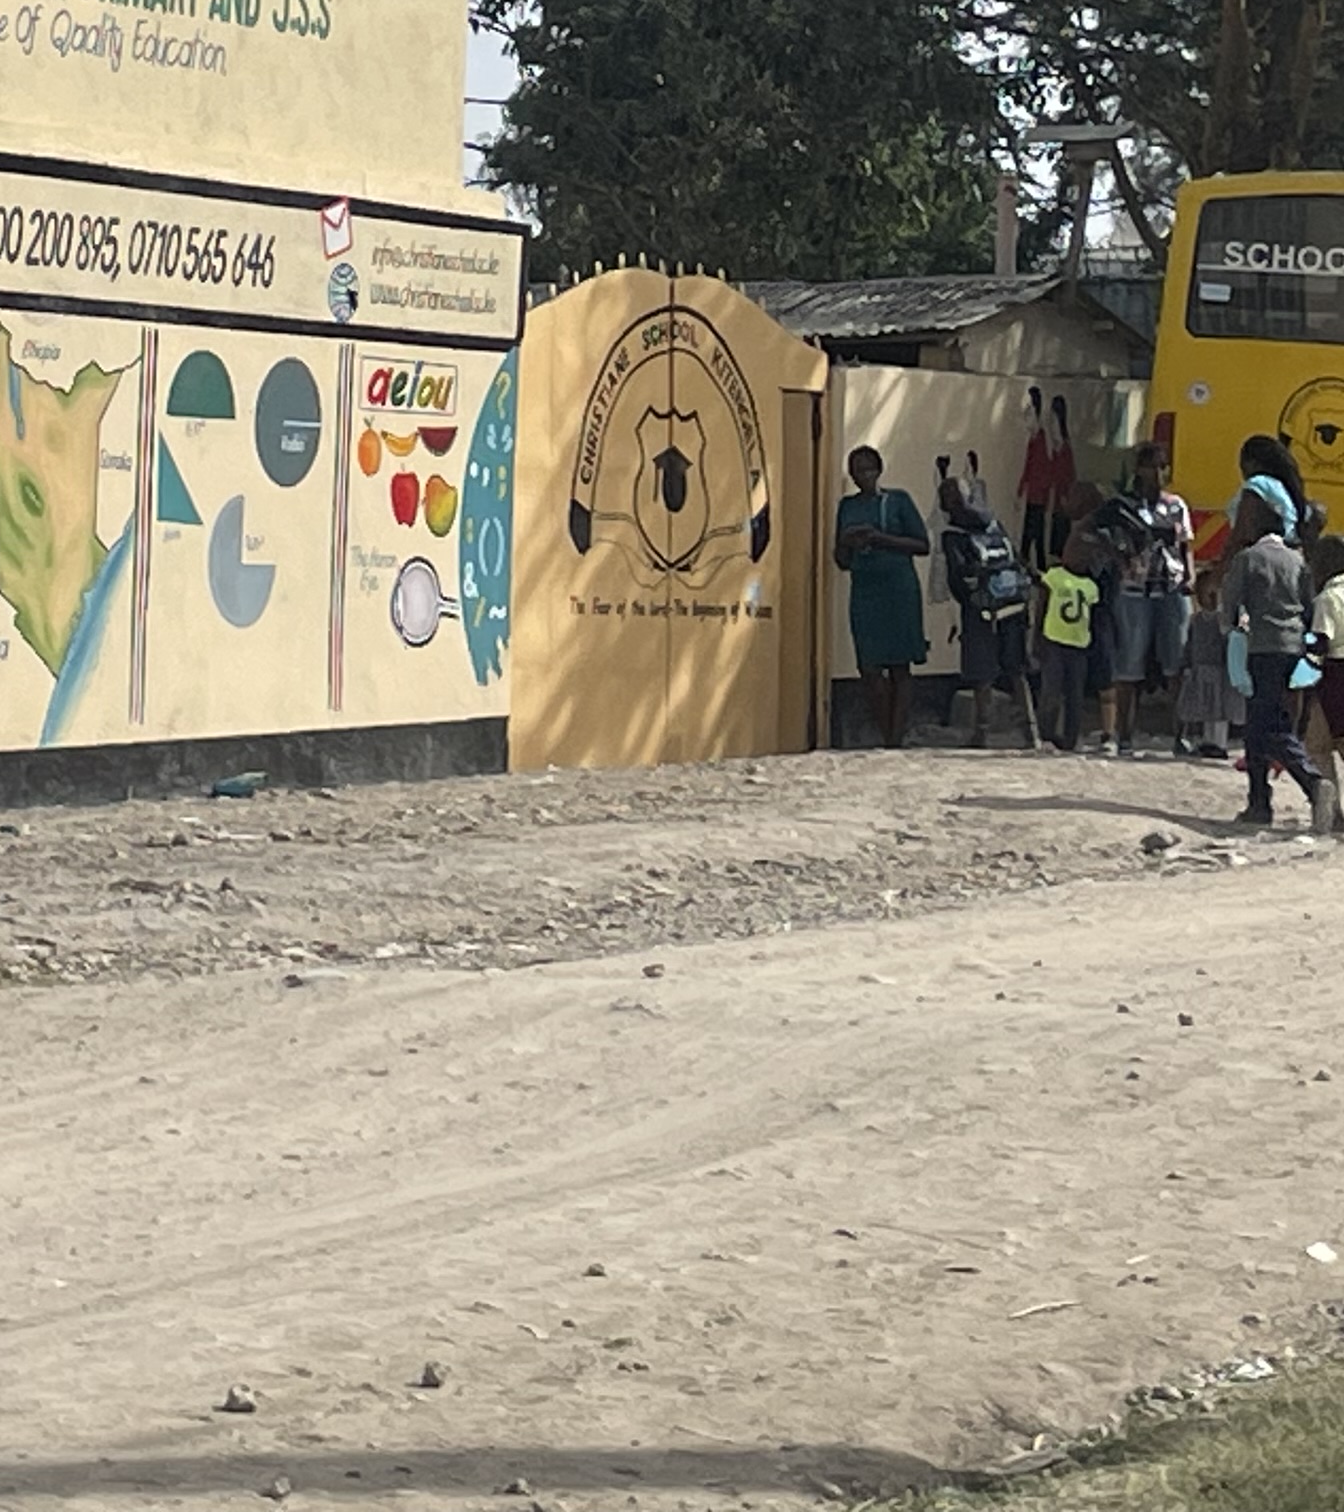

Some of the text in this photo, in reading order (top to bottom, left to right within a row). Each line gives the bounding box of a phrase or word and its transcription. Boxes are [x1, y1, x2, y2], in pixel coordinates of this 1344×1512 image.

[25, 209, 74, 268] 200
[128, 220, 182, 277] 0710
[182, 227, 228, 284] 565
[232, 232, 276, 289] 646
[366, 361, 453, 411] aeiou
[579, 346, 631, 486] CHRISTIANE
[641, 320, 700, 352] SCHOOL
